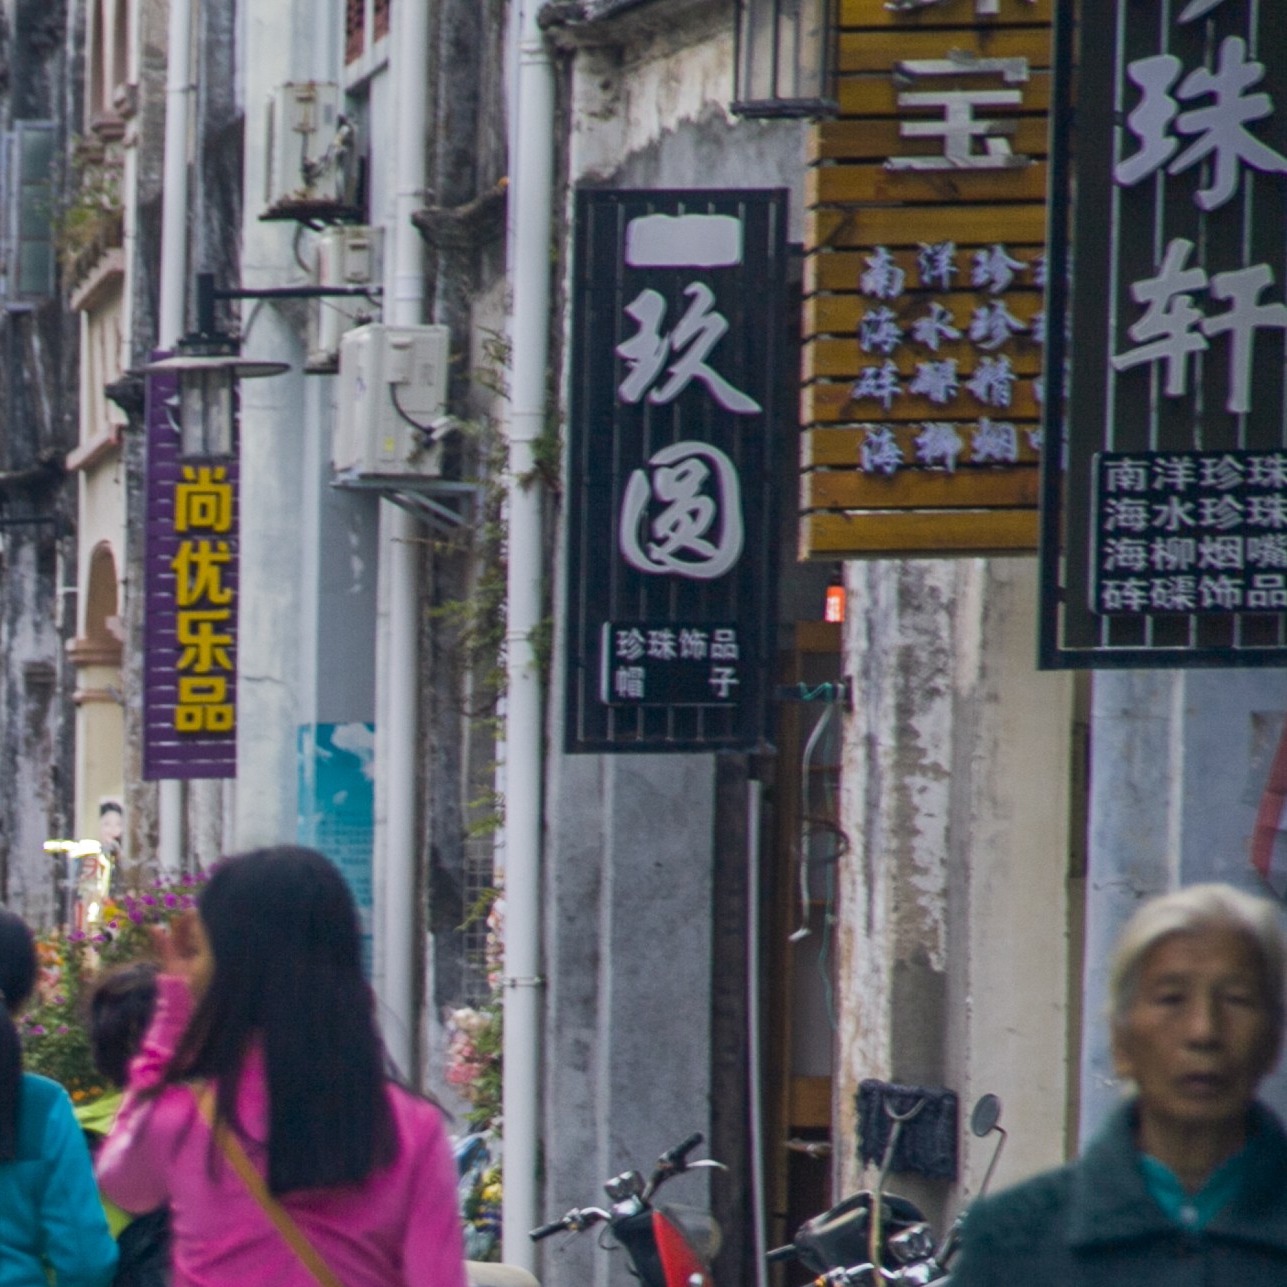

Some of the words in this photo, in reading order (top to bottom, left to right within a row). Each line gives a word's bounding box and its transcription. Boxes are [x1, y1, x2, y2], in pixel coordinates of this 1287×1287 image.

[1111, 0, 1287, 413] 珠轩
[851, 354, 1044, 409] 砗磲精
[860, 417, 1043, 474] 海柳烟
[1104, 453, 1287, 493] 南洋珍珠
[1103, 493, 1287, 533] 海水珍珠
[1101, 532, 1287, 573] 海柳烟嘴
[171, 465, 234, 733] 尚优乐品
[614, 629, 739, 661] 珍珠饰品
